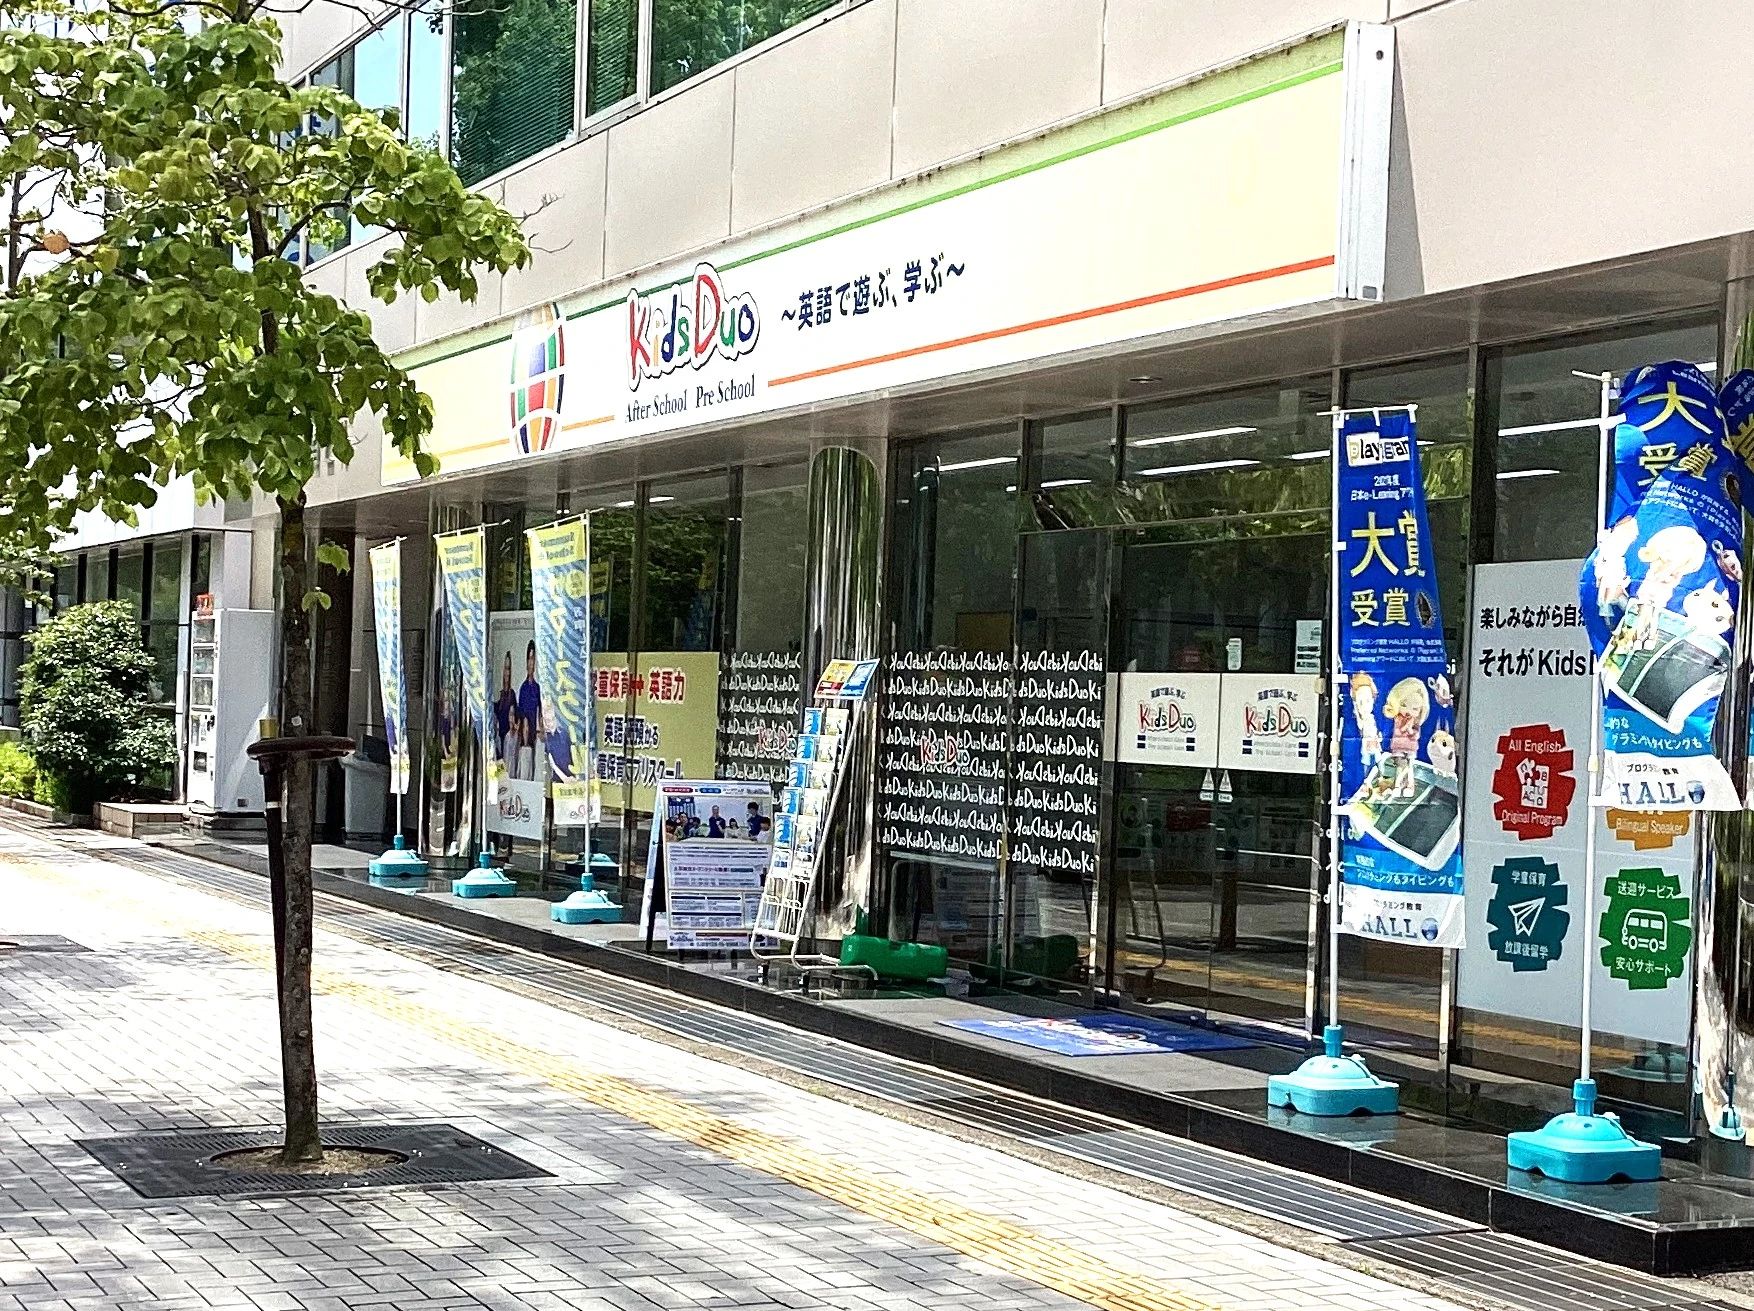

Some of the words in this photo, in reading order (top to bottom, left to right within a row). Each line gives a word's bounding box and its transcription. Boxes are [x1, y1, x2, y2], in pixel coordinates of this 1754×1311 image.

[625, 400, 652, 424] After
[652, 388, 688, 418] School
[695, 385, 715, 409] Pre
[717, 372, 756, 404] School
[1350, 510, 1426, 577] 大賞
[1350, 588, 1411, 627] 受賞
[1139, 702, 1195, 730] KidsDuo
[1244, 705, 1308, 734] KidsDuo
[1509, 739, 1522, 752] All
[1524, 739, 1562, 754] English
[1501, 809, 1530, 825] Original
[1531, 811, 1563, 827] Program
[1615, 817, 1648, 833] Bilingual
[1650, 819, 1684, 836] Speaker
[1617, 880, 1674, 899] 送迎サービス
[1615, 956, 1671, 977] 安心サポート
